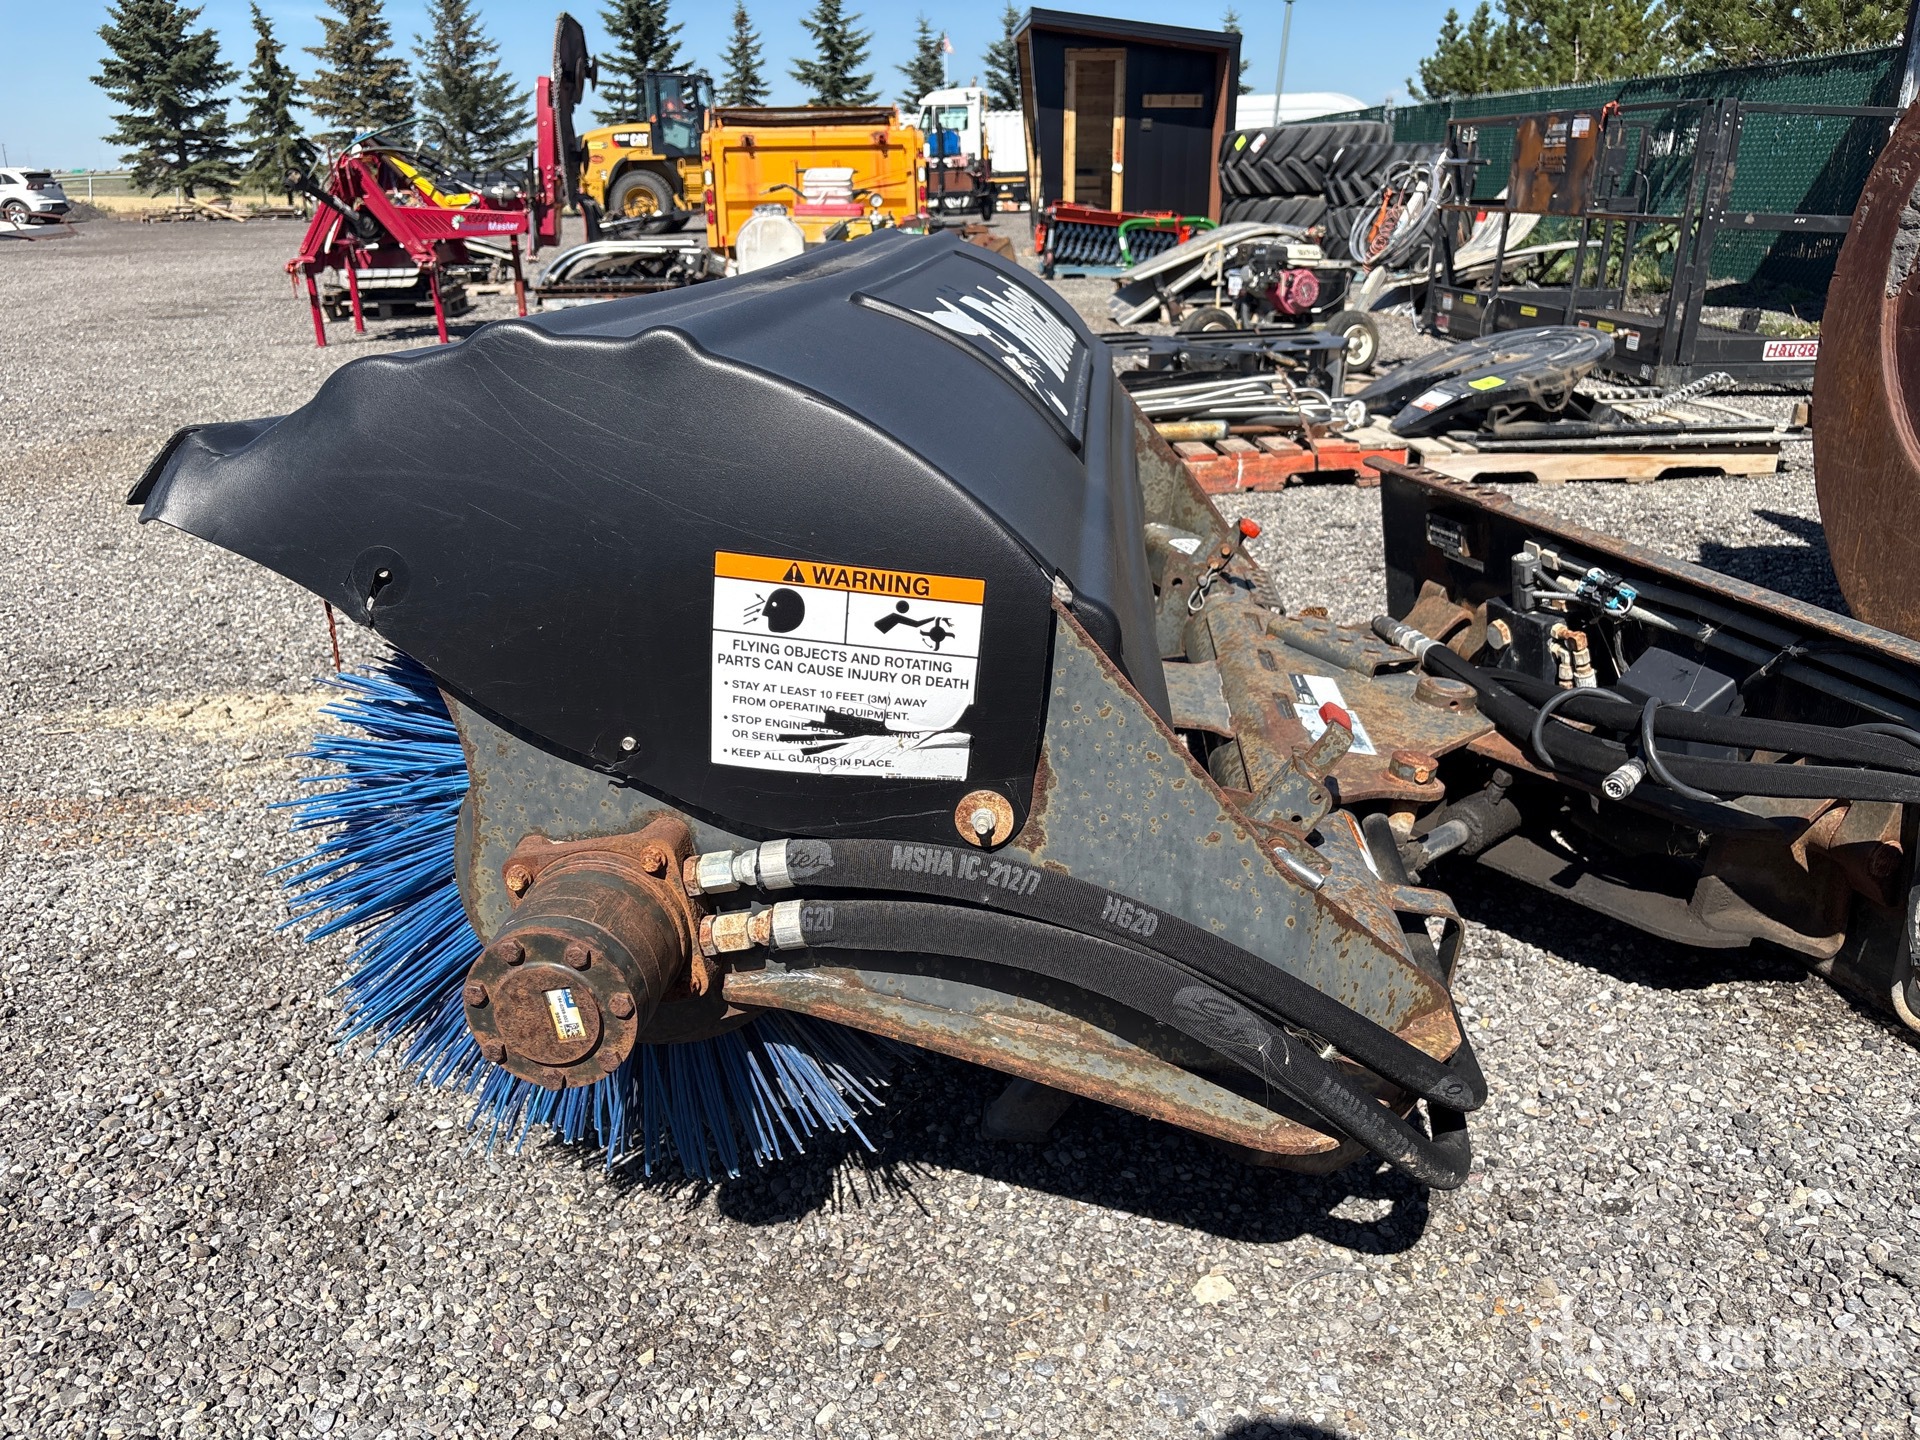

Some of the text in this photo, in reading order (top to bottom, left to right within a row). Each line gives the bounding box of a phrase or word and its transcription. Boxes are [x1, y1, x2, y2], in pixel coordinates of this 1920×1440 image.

[488, 221, 519, 231] Master
[959, 275, 1077, 384] Bobcat
[812, 566, 930, 596] WARNING
[732, 639, 953, 673] FLYING OBJECTS AND ROTATING
[717, 653, 969, 690] PARTS CAN CAUSE INJURY OR DEATH
[731, 680, 928, 708] STAY AT LEAST 10 FEET (3M) AWAY
[732, 695, 910, 721] FROM OPERATING EQUIPMENT.
[731, 714, 762, 725] STOP
[765, 718, 808, 731] ENGINE
[732, 729, 749, 739] OR
[731, 747, 895, 768] KEEP ALL GUARDS IN PLACE.
[787, 850, 829, 869] tes
[891, 845, 953, 877] MSHA
[801, 906, 835, 932] G20
[1101, 895, 1158, 937] HG20
